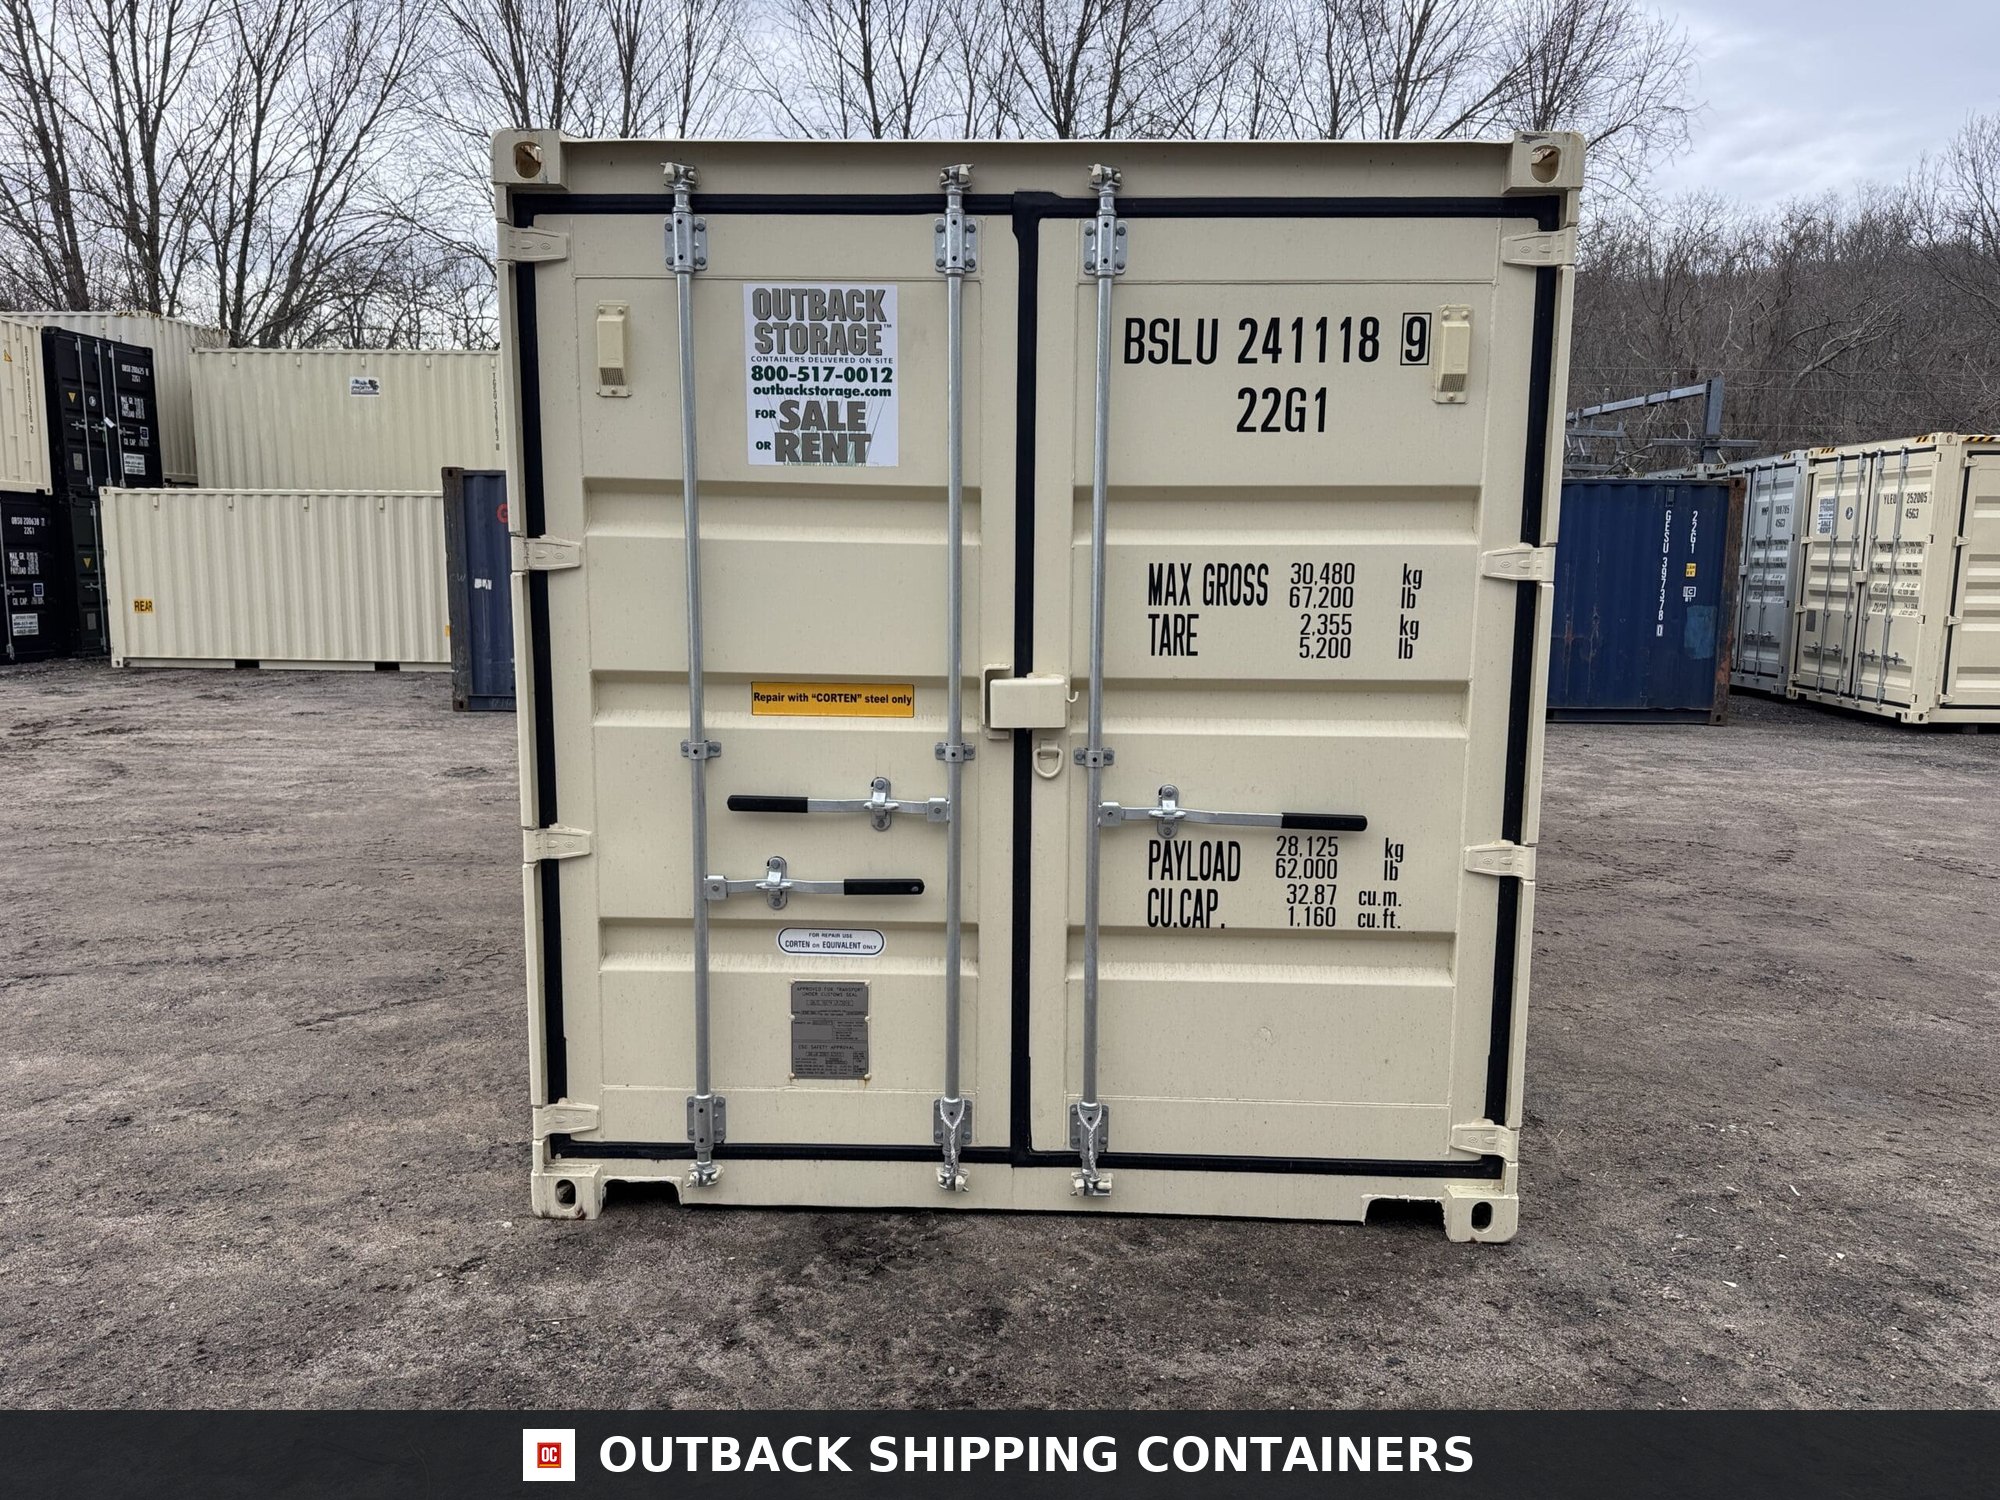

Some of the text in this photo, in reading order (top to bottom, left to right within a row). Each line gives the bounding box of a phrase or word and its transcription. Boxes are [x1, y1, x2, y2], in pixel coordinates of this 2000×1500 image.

[752, 288, 887, 322] OUTBACK
[754, 322, 883, 356] STORAGE
[1123, 314, 1429, 365] BSLU 241118 9
[751, 365, 893, 383] 800-517-0012
[753, 384, 892, 398] outbackstorage.com
[755, 399, 867, 431] FOR SALE
[1236, 387, 1327, 433] 22G1
[755, 432, 872, 463] OR RENT
[1663, 510, 1672, 553] GESU
[1690, 510, 1698, 554] 22G1
[1148, 563, 1423, 606] MAX GROSS 30,480 kg
[1289, 587, 1416, 609] 67,200 lb
[1658, 557, 1667, 620] 397378
[134, 600, 153, 612] REAR
[1148, 613, 1420, 656] TARE 2,355 kg
[1299, 637, 1413, 659] 5,200 lb
[753, 692, 785, 704] Repair
[788, 693, 808, 702] with
[865, 694, 888, 703] steel
[892, 694, 912, 706] only
[1148, 836, 1404, 882] PAYLOAD 28,125 kg
[1275, 858, 1398, 880] 62,000 lb
[1286, 884, 1337, 905] 32.87
[1358, 890, 1402, 907] cu.m.
[1288, 906, 1401, 929] 1,160 cu.ft.
[785, 940, 810, 948] CORTEN
[822, 941, 861, 949] EQUIVALENT
